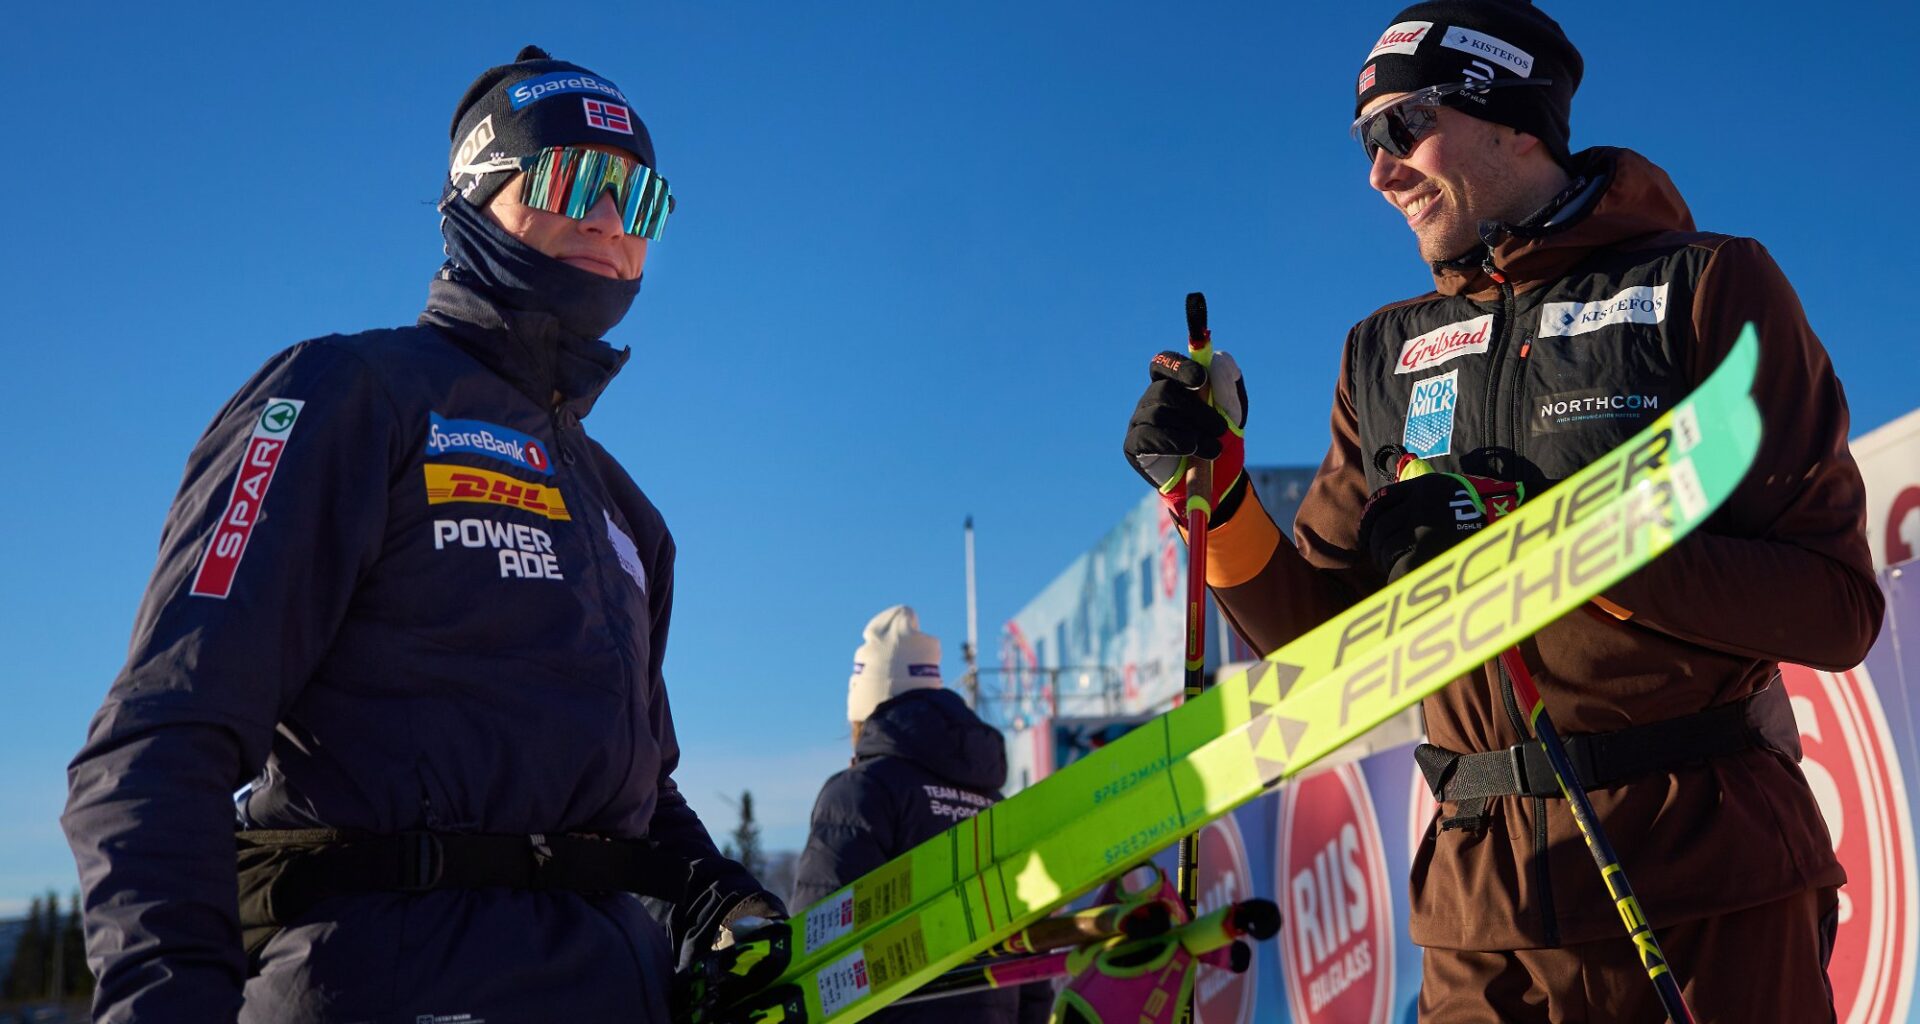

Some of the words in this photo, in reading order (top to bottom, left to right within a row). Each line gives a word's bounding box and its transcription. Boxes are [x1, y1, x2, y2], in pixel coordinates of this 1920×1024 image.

[1470, 39, 1530, 70] KISTEFOS
[1581, 296, 1663, 324] KISTEFOS
[1401, 321, 1488, 369] Grilstad
[1412, 392, 1455, 418] MILK
[1416, 378, 1455, 400] NOR
[1541, 395, 1658, 417] NORTHCOM
[429, 424, 525, 462] SpareBank
[216, 440, 279, 559] SPAR
[450, 472, 549, 511] DHL
[433, 518, 554, 553] POWER
[1333, 428, 1673, 670] FISCHER
[498, 550, 564, 581] ADE
[1339, 480, 1675, 728] FISCHER
[923, 785, 959, 800] TEAM
[1293, 822, 1369, 977] RIIS
[1601, 863, 1669, 981] LEKI
[1308, 939, 1372, 1015] BILGLASS
